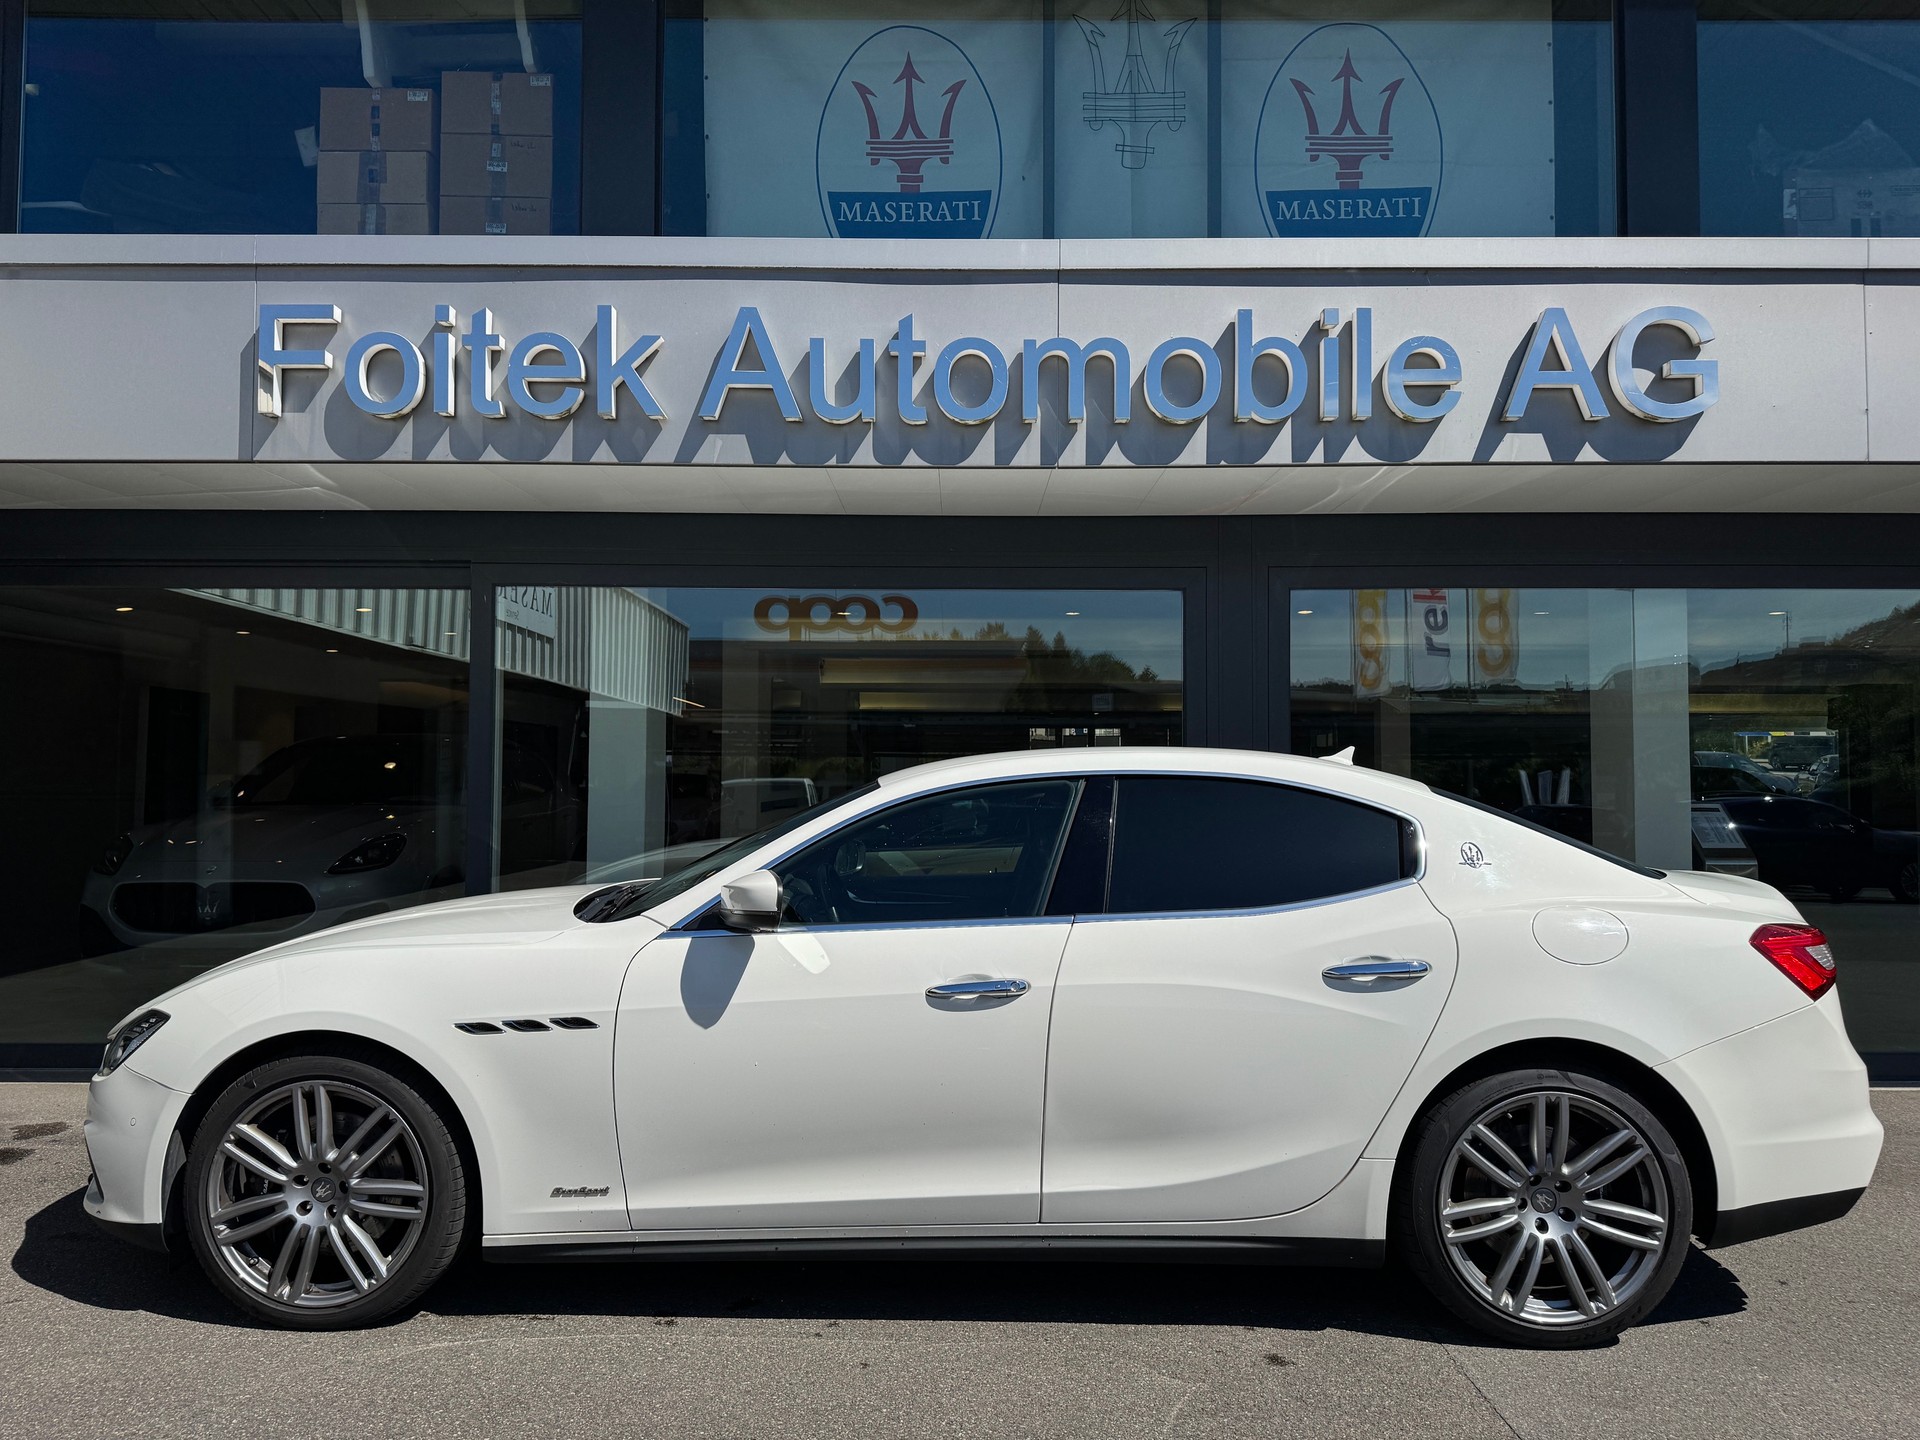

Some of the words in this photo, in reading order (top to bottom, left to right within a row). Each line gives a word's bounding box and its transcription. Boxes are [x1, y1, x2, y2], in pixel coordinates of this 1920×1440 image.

[837, 199, 983, 224] MASERATI
[1276, 196, 1423, 222] MASERATI
[257, 303, 667, 421] Foitek
[698, 305, 1463, 425] Automobile
[1501, 305, 1720, 423] AG
